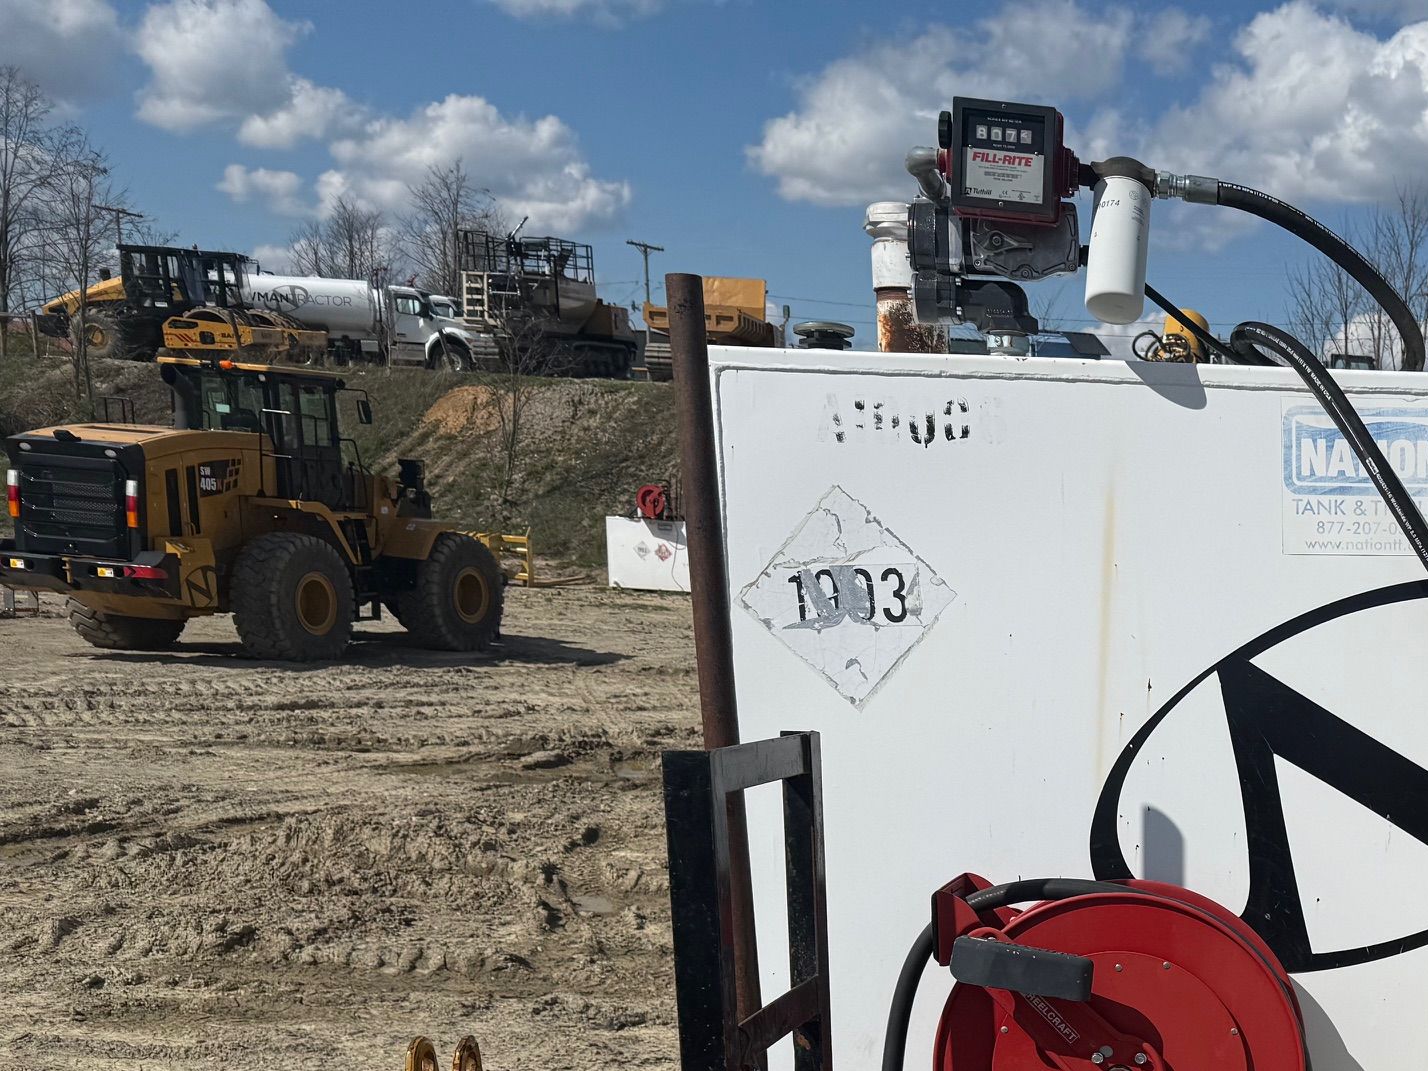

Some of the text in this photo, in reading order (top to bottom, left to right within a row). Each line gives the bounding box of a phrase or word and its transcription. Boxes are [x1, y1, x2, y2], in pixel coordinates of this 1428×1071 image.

[972, 151, 1034, 168] FILL-RITE
[1292, 498, 1347, 516] TANK
[1354, 499, 1367, 516] &
